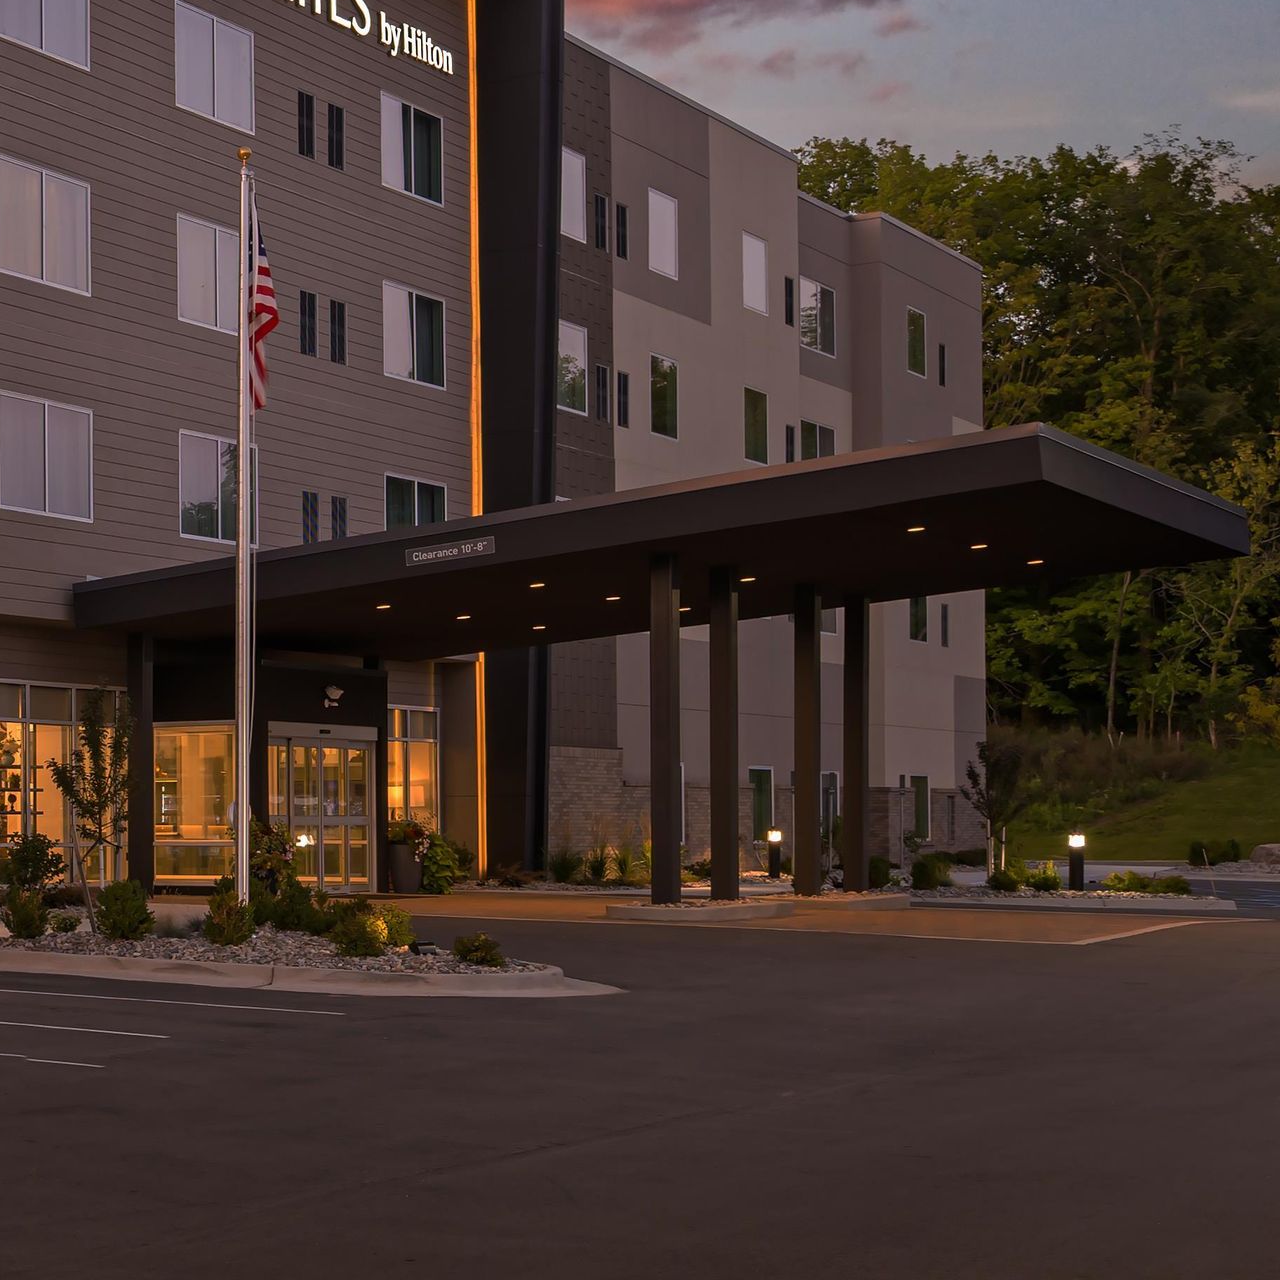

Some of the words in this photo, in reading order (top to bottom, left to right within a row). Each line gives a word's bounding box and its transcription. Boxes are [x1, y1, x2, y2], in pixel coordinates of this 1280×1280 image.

[380, 10, 402, 57] by
[403, 23, 454, 75] Hilton
[412, 548, 458, 561] Clearance
